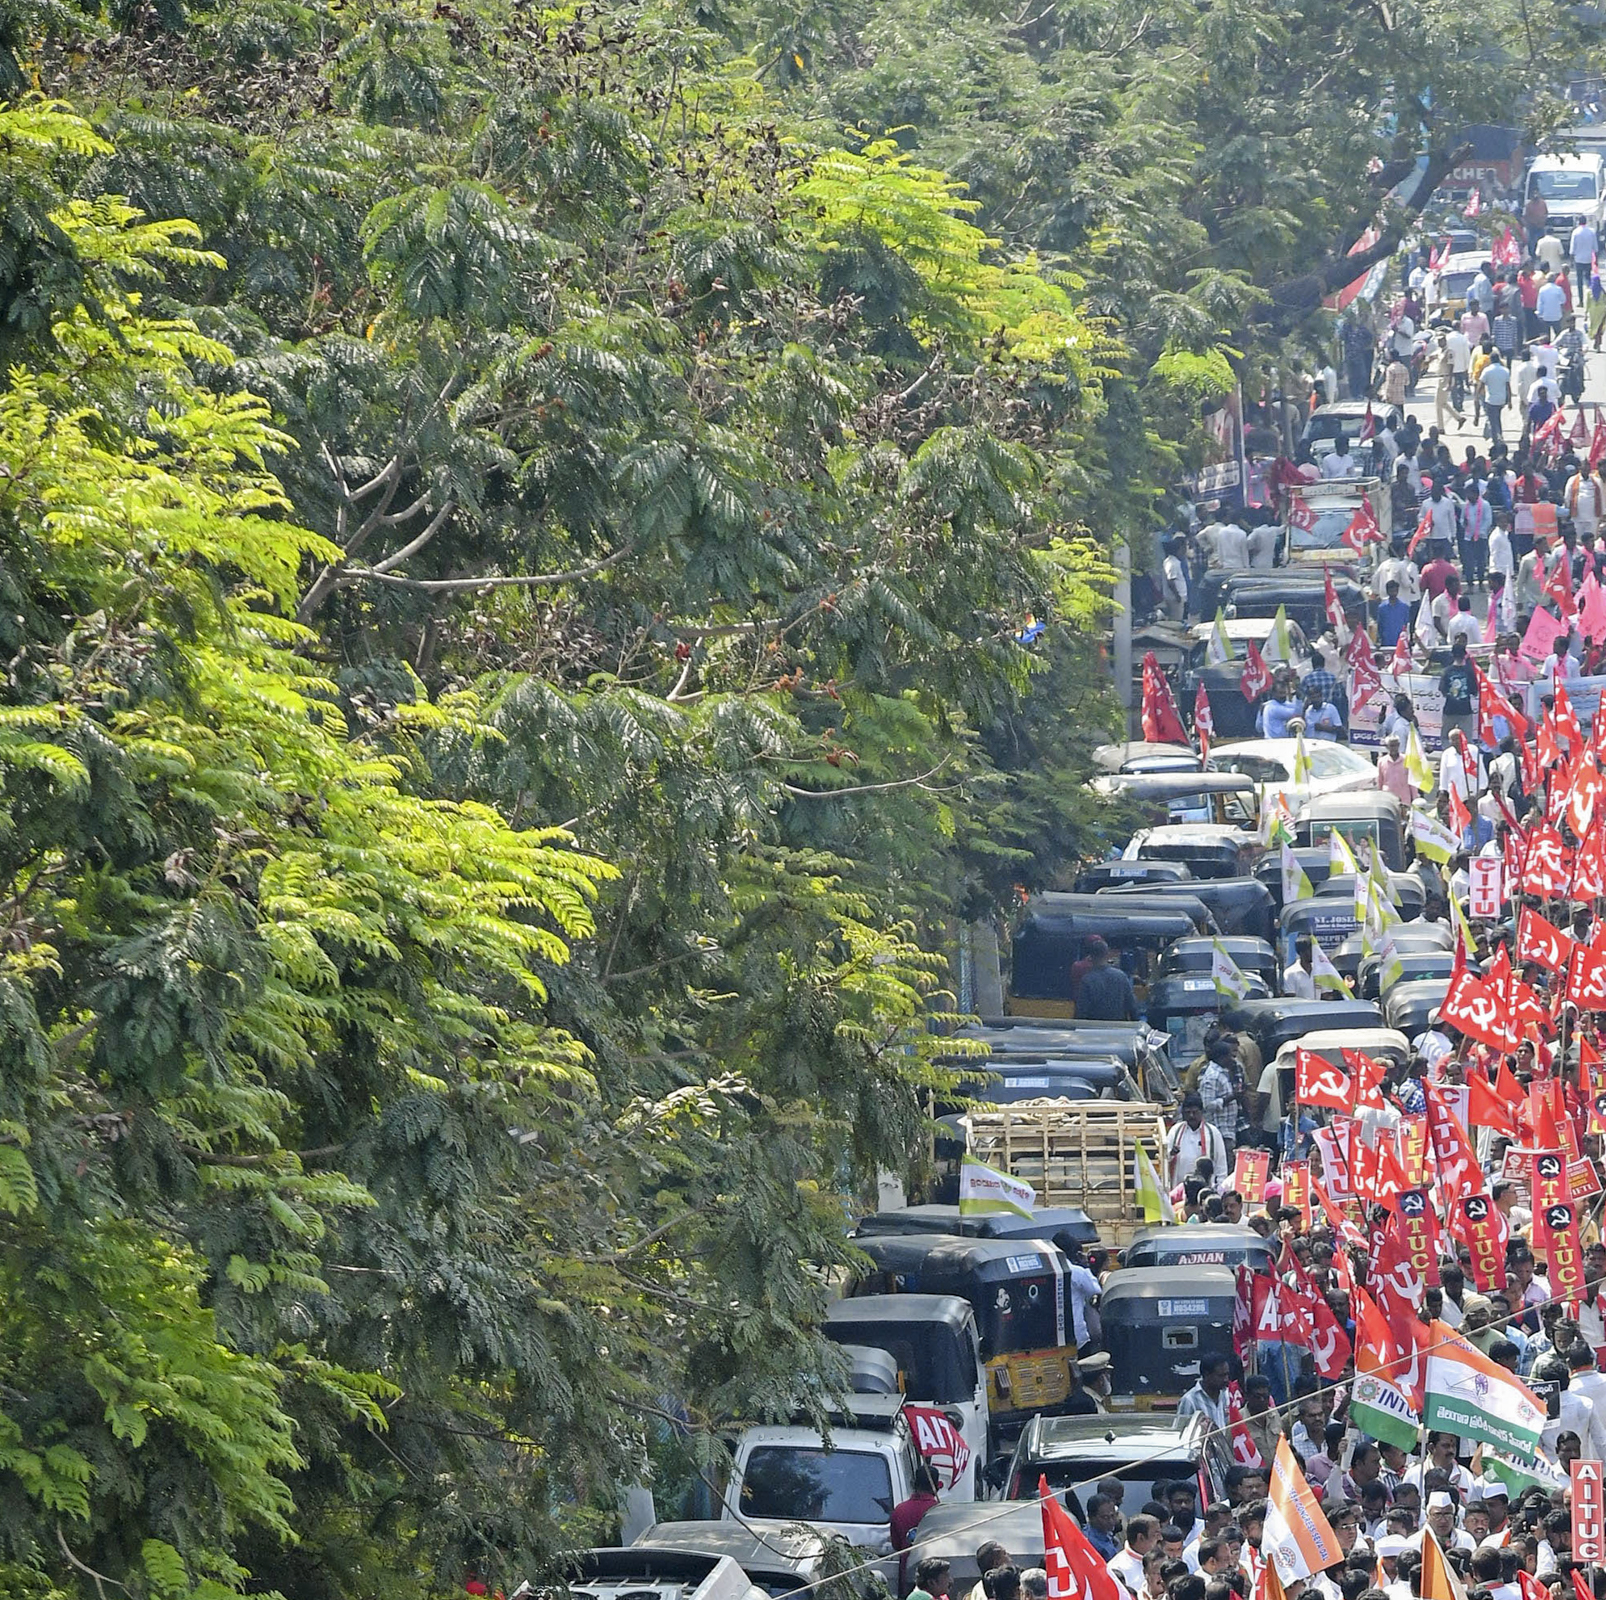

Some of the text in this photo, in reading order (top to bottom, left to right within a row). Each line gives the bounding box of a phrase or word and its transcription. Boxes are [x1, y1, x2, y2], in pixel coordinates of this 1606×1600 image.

[1474, 859, 1498, 916] CITU
[1297, 1050, 1310, 1100] CITU
[1176, 1253, 1225, 1265] ADNAN
[1552, 1230, 1580, 1300] TUCI
[1576, 1465, 1600, 1558] AITUC
